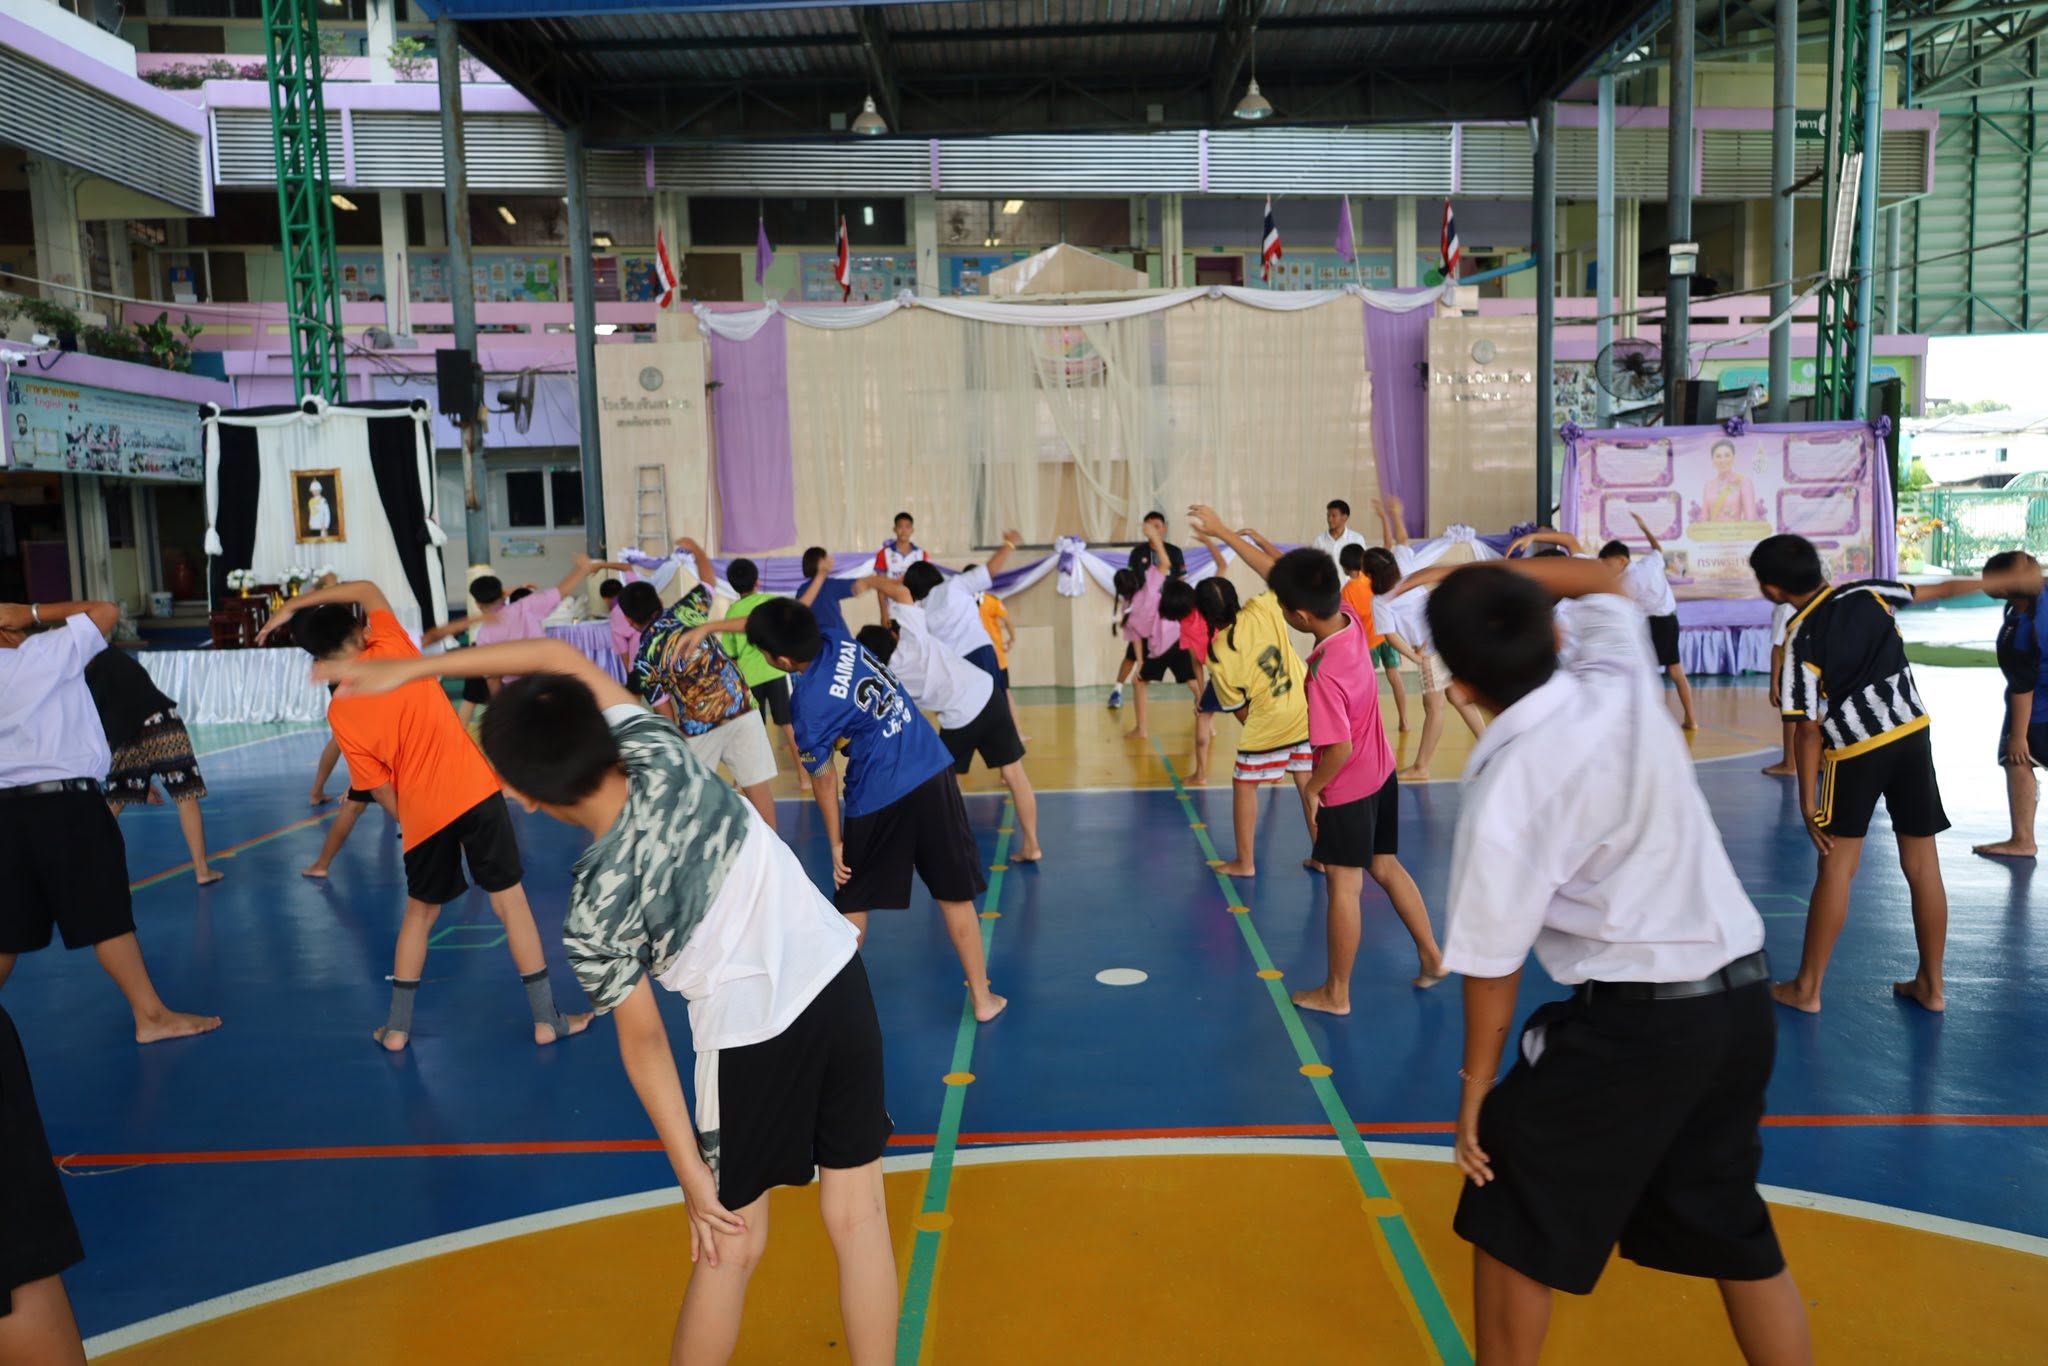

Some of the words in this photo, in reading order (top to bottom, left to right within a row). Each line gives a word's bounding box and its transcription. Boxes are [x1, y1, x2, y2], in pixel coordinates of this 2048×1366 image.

[34, 396, 64, 410] English
[1697, 556, 1749, 568] ทรงพระเจ
[829, 641, 858, 700] BAIMAI
